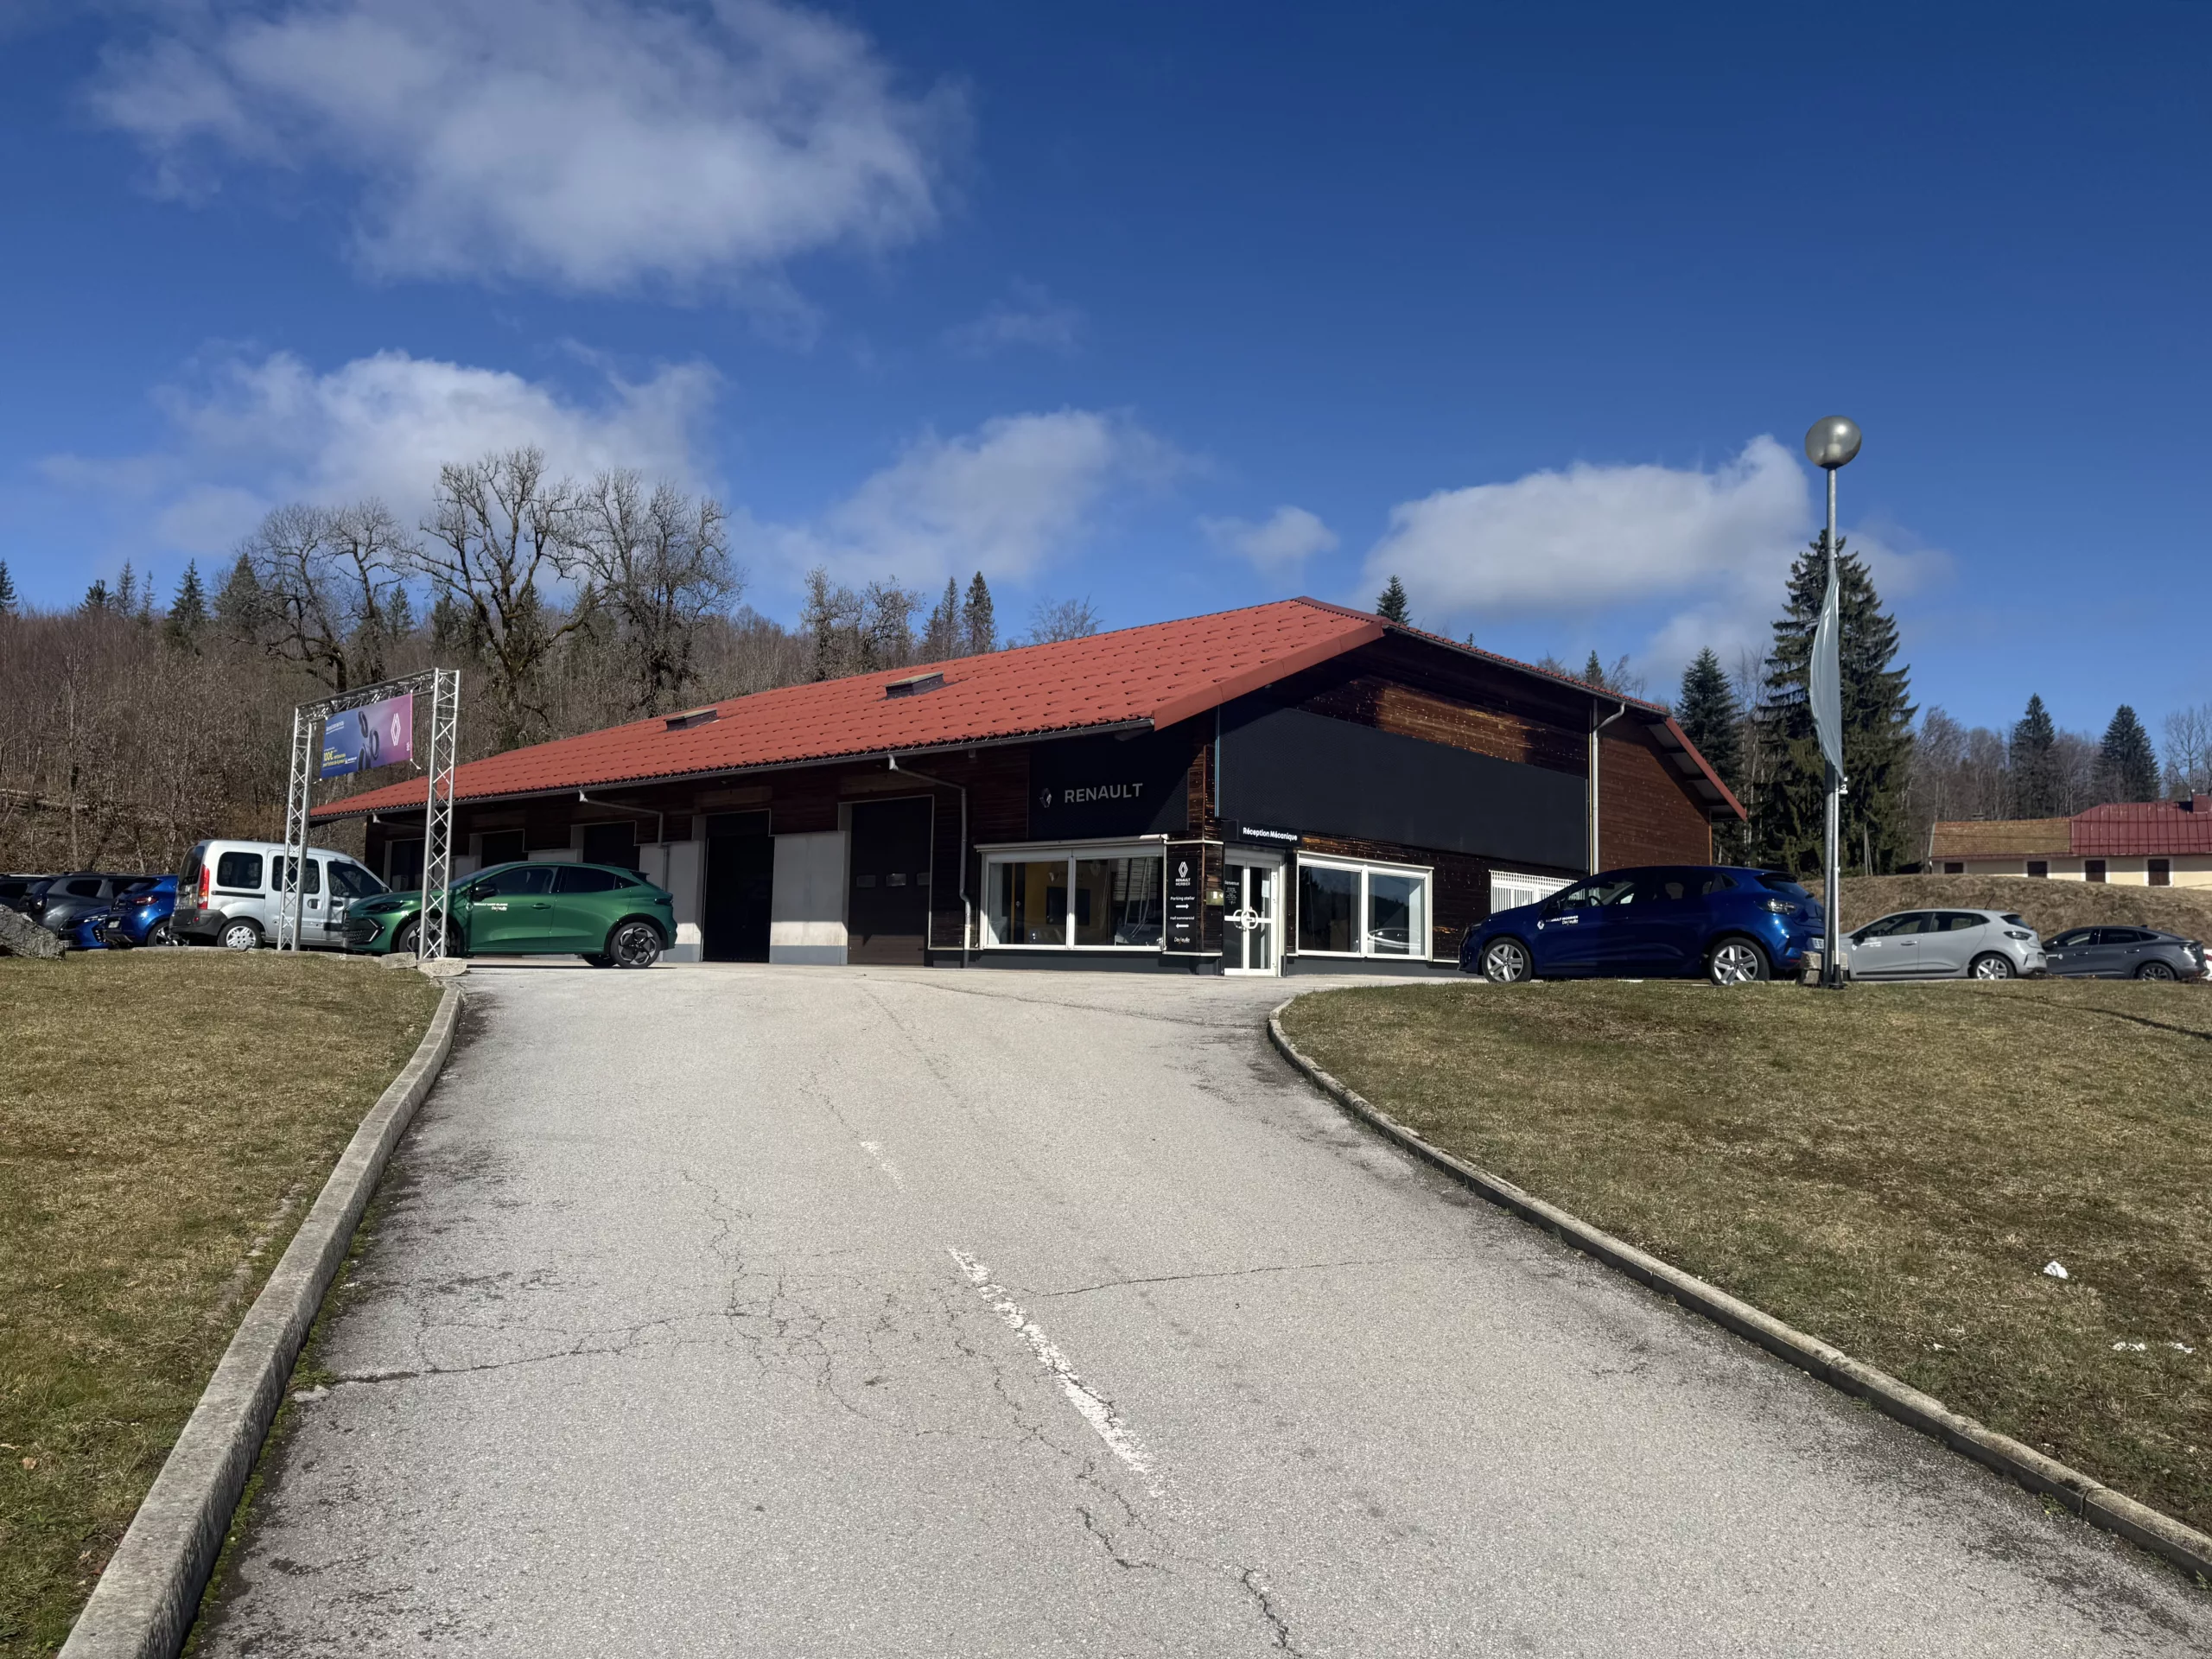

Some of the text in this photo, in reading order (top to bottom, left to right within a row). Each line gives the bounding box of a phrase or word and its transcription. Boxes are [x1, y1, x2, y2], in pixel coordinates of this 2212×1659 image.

[1064, 783, 1143, 803] RENAULT
[1243, 827, 1298, 842] Réception Mécanique
